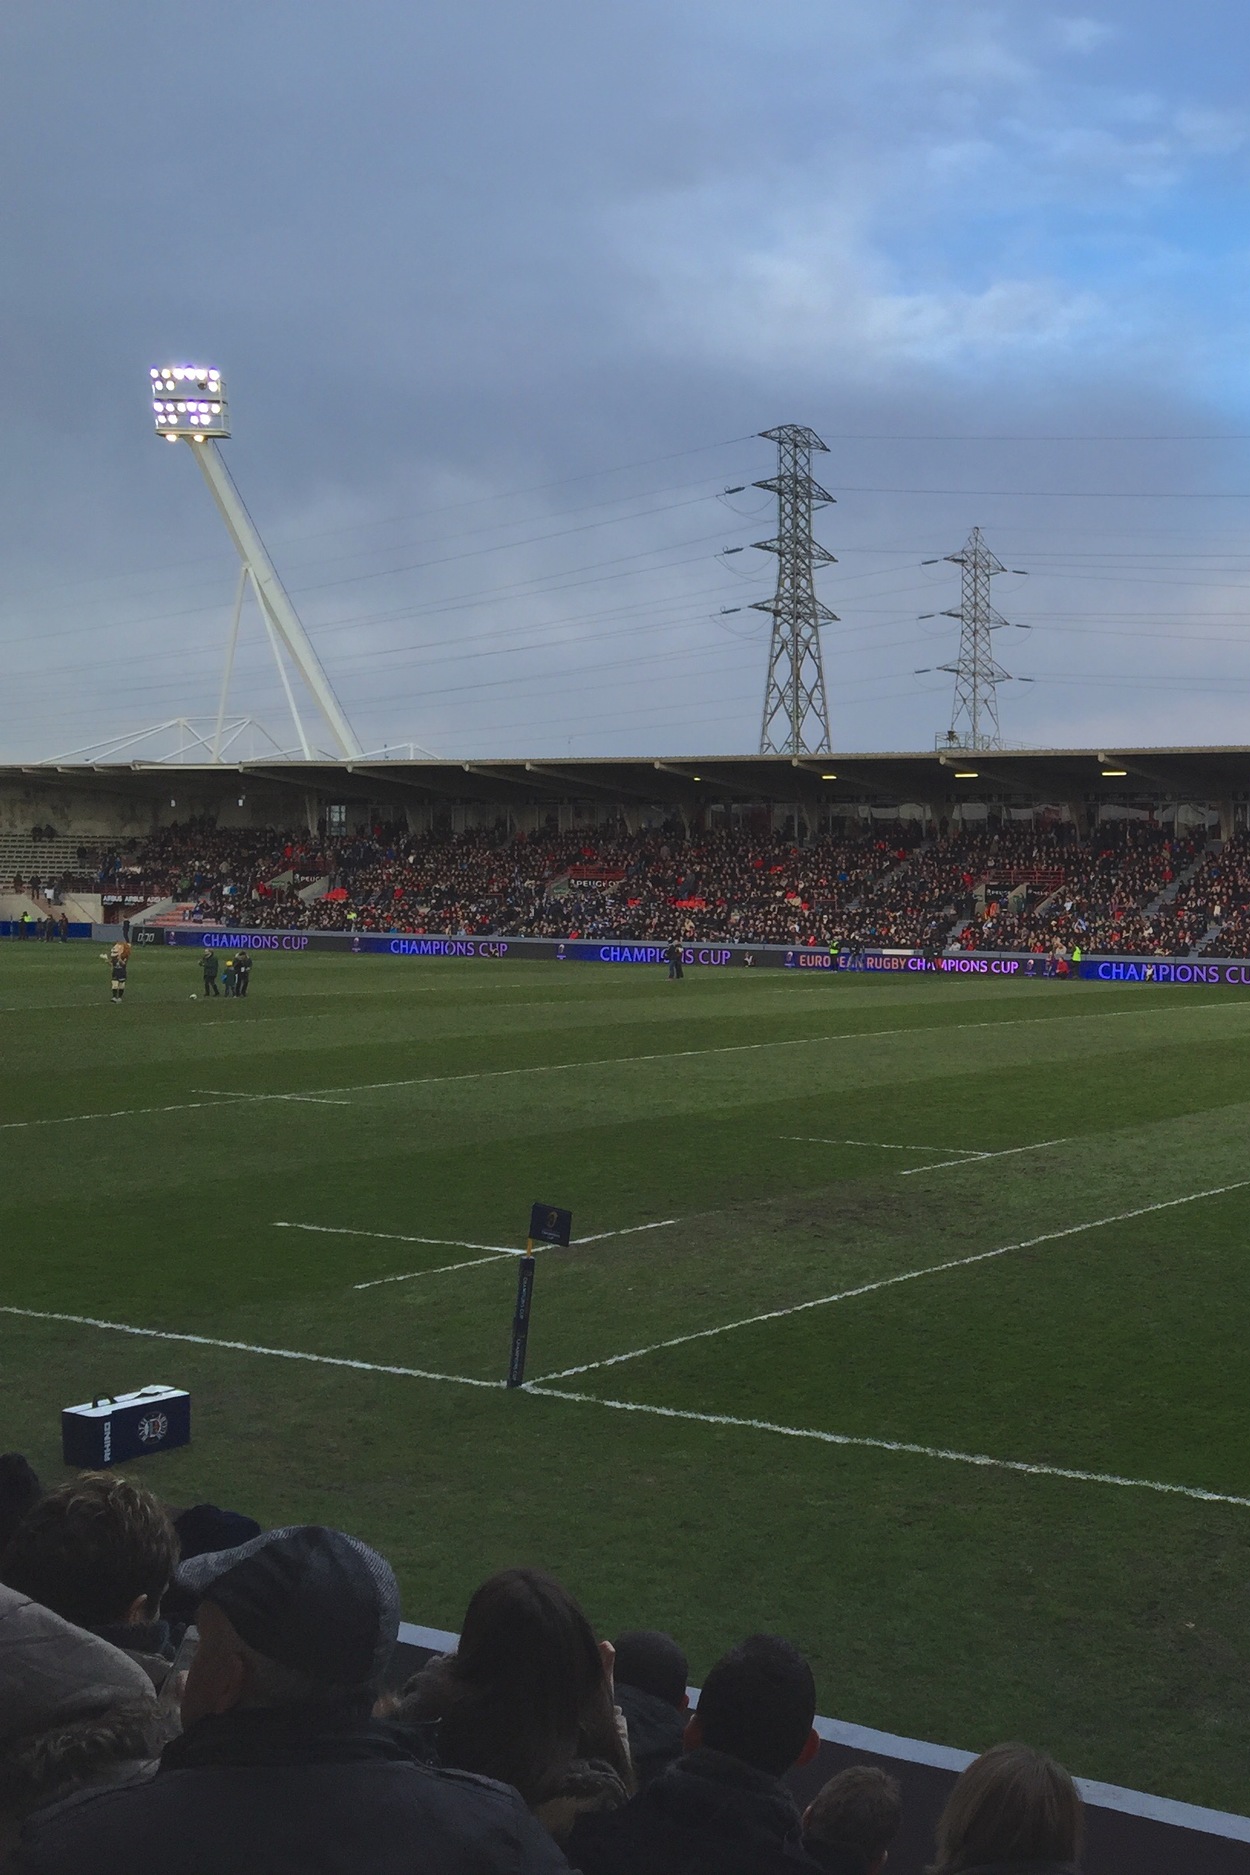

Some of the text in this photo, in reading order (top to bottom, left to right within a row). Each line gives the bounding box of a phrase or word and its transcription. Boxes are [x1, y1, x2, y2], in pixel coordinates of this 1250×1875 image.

[202, 933, 308, 950] CHAMPIONS CUP
[390, 939, 475, 956] CHAMPIONS
[600, 946, 731, 965] CHAMPIS CUP
[866, 956, 906, 970] RUGBY
[991, 960, 1019, 974] CUP
[1098, 962, 1219, 983] CHAMPIONS
